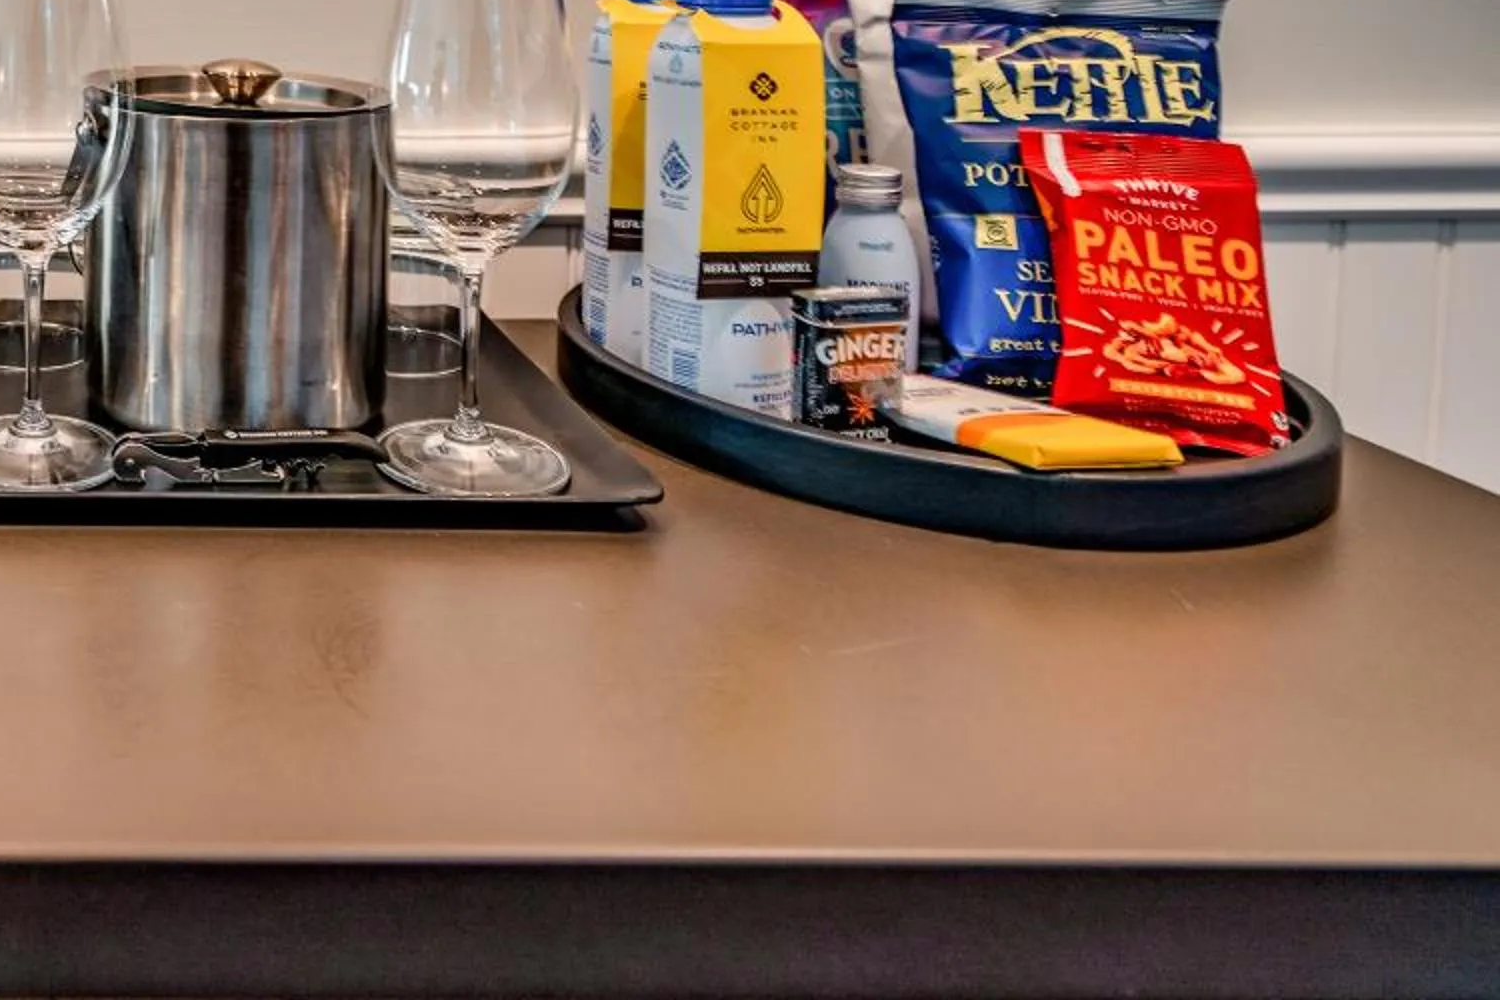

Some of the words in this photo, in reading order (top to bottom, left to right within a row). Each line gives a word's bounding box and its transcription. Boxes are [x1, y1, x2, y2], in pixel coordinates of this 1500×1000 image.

[942, 25, 1216, 125] KETTLE
[729, 121, 798, 131] COTTAGE
[963, 162, 1029, 187] POT
[1113, 178, 1200, 200] THRIVE
[1103, 207, 1218, 236] NON-GMO
[1073, 219, 1259, 281] PALEO
[739, 262, 762, 273] NOT
[1017, 260, 1054, 283] SE
[1077, 262, 1188, 299] SNACK
[1197, 277, 1263, 309] MIX
[815, 332, 907, 366] GINGER
